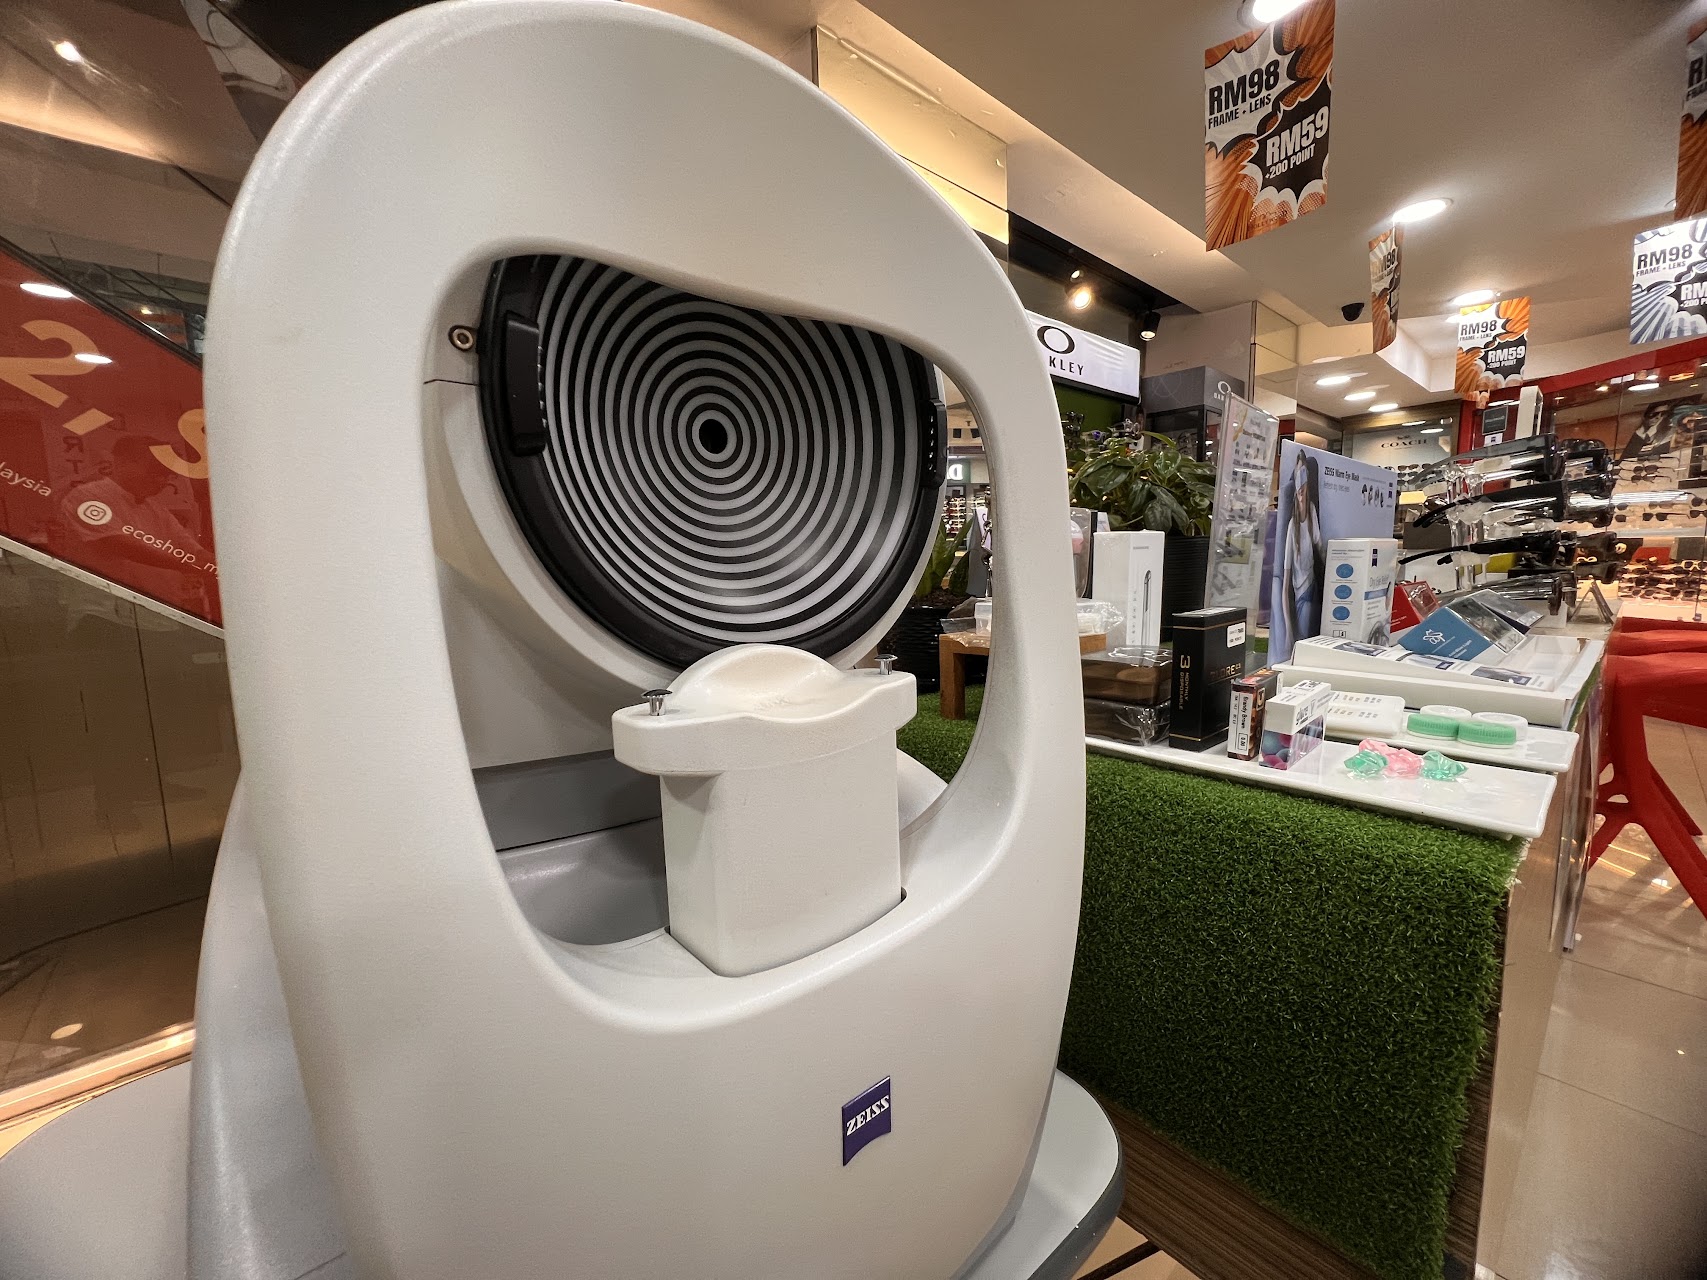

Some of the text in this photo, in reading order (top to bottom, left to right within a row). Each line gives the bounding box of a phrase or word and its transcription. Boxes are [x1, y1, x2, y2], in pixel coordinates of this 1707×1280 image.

[1209, 59, 1280, 117] RM98
[1208, 108, 1240, 130] FRAME
[1250, 93, 1272, 114] LENS
[1266, 105, 1329, 167] RM59
[1290, 143, 1316, 169] POINT
[1637, 243, 1693, 270] RM98
[1636, 266, 1660, 278] FRAME
[1668, 261, 1686, 270] LENS
[1460, 320, 1498, 336] RM98
[1487, 345, 1526, 363] RM59
[1501, 359, 1517, 367] POINT
[1381, 439, 1428, 449] COACH
[1180, 654, 1191, 669] 3
[1240, 696, 1249, 713] Brandy
[846, 1094, 890, 1137] ZEISS
